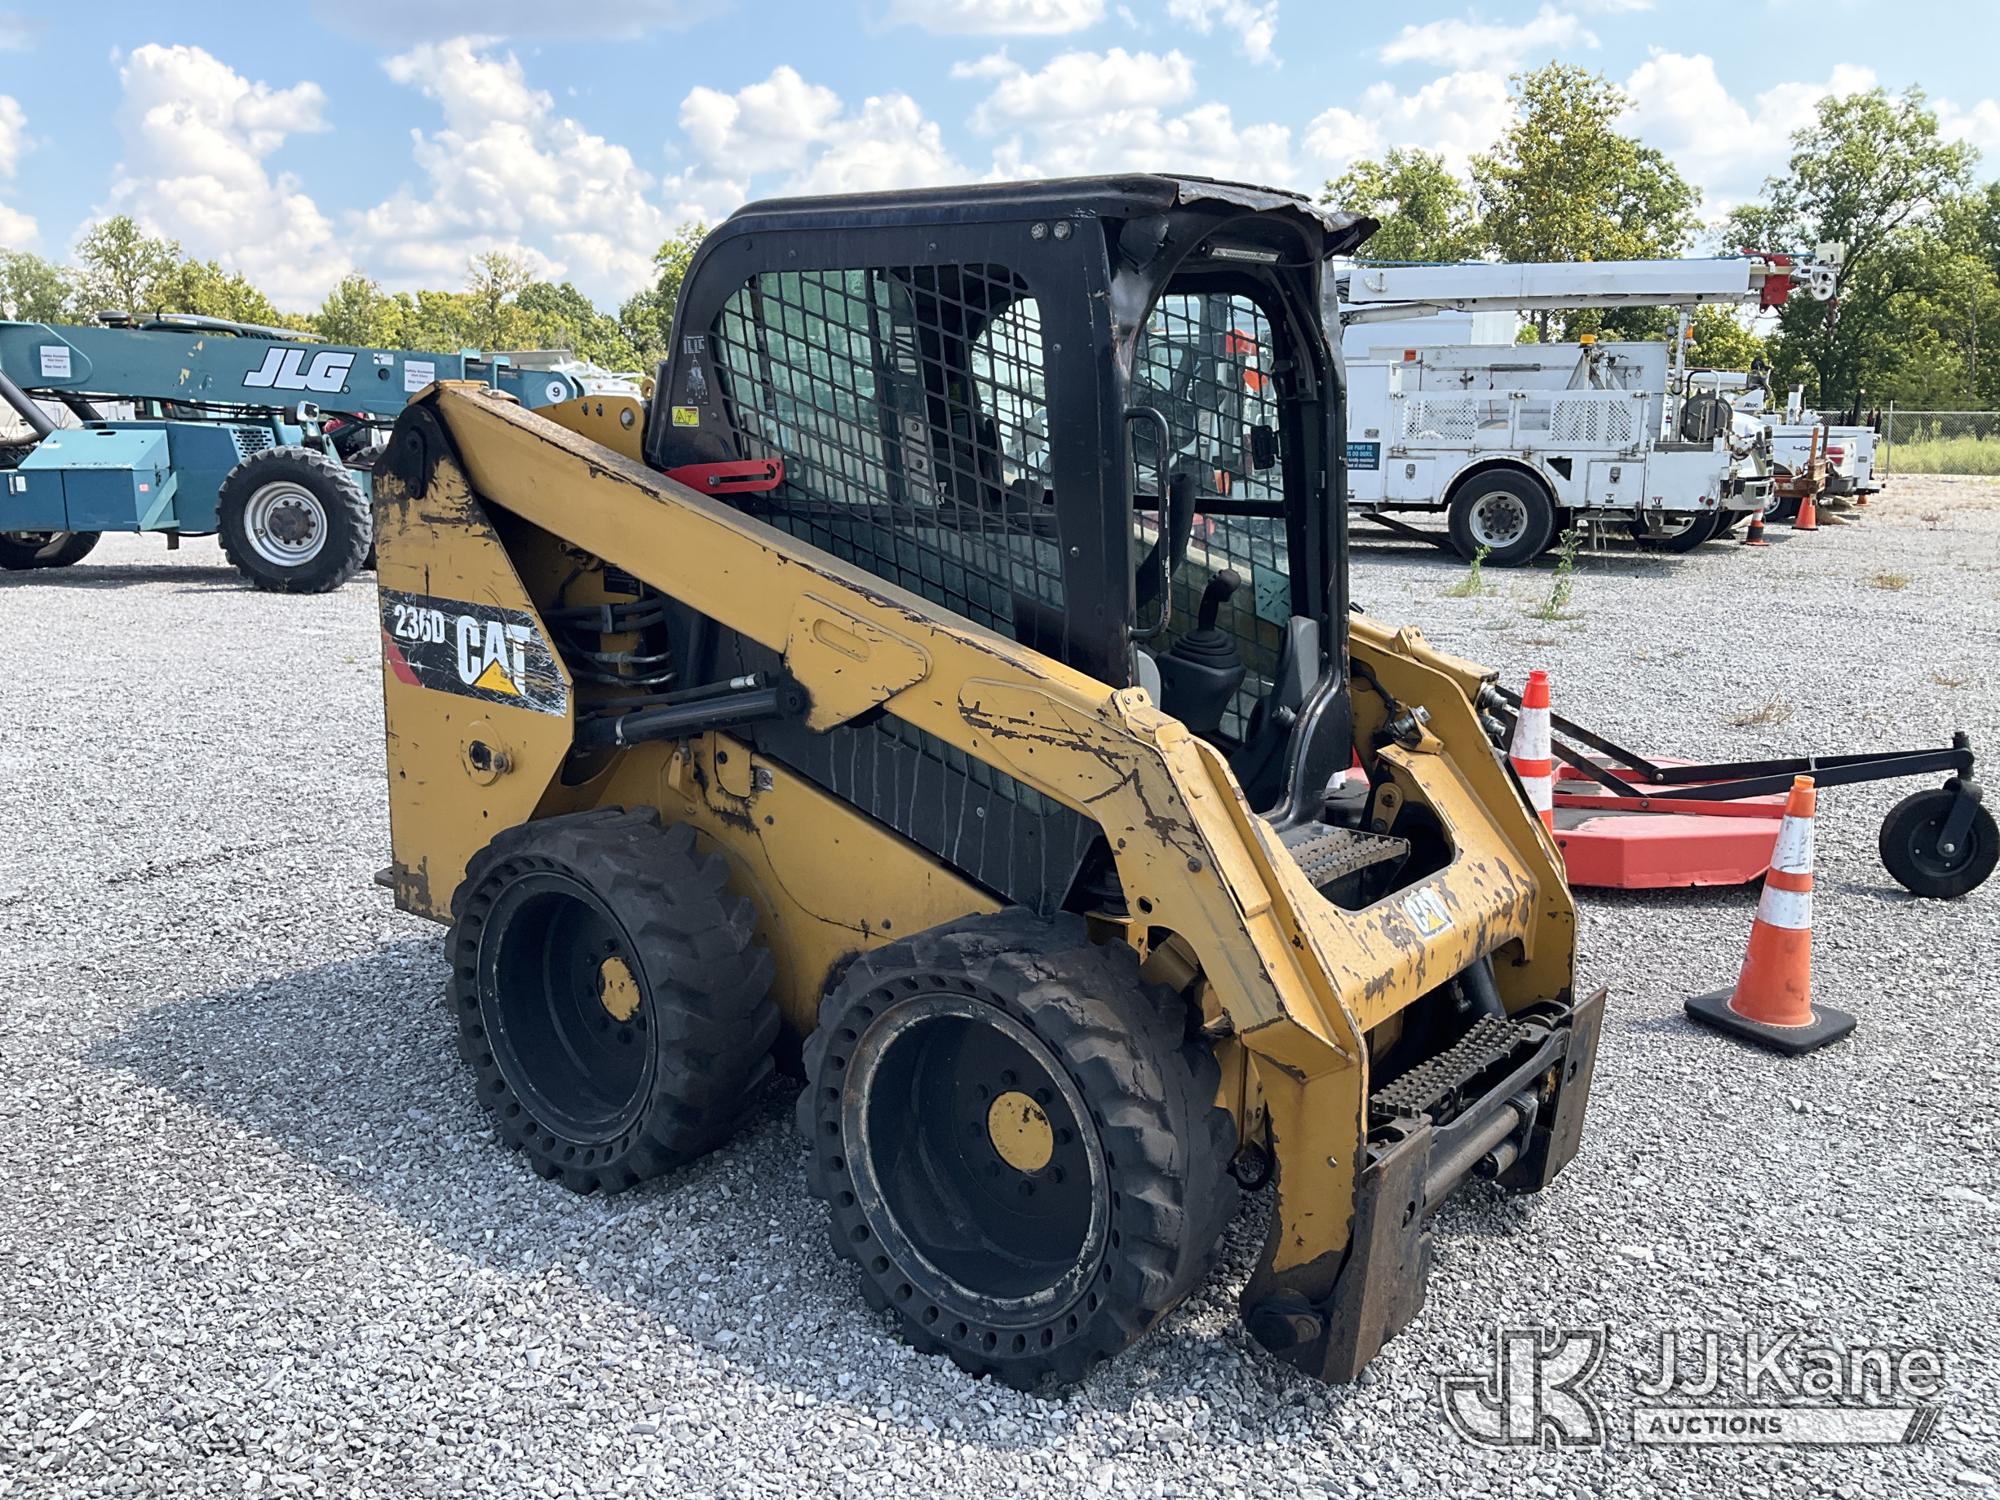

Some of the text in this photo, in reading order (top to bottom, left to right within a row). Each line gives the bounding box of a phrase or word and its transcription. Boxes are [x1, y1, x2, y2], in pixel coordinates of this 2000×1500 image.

[242, 346, 357, 393] JLG
[552, 386, 561, 397] 9
[394, 604, 531, 696] 236D CAT
[1404, 888, 1453, 933] CAT
